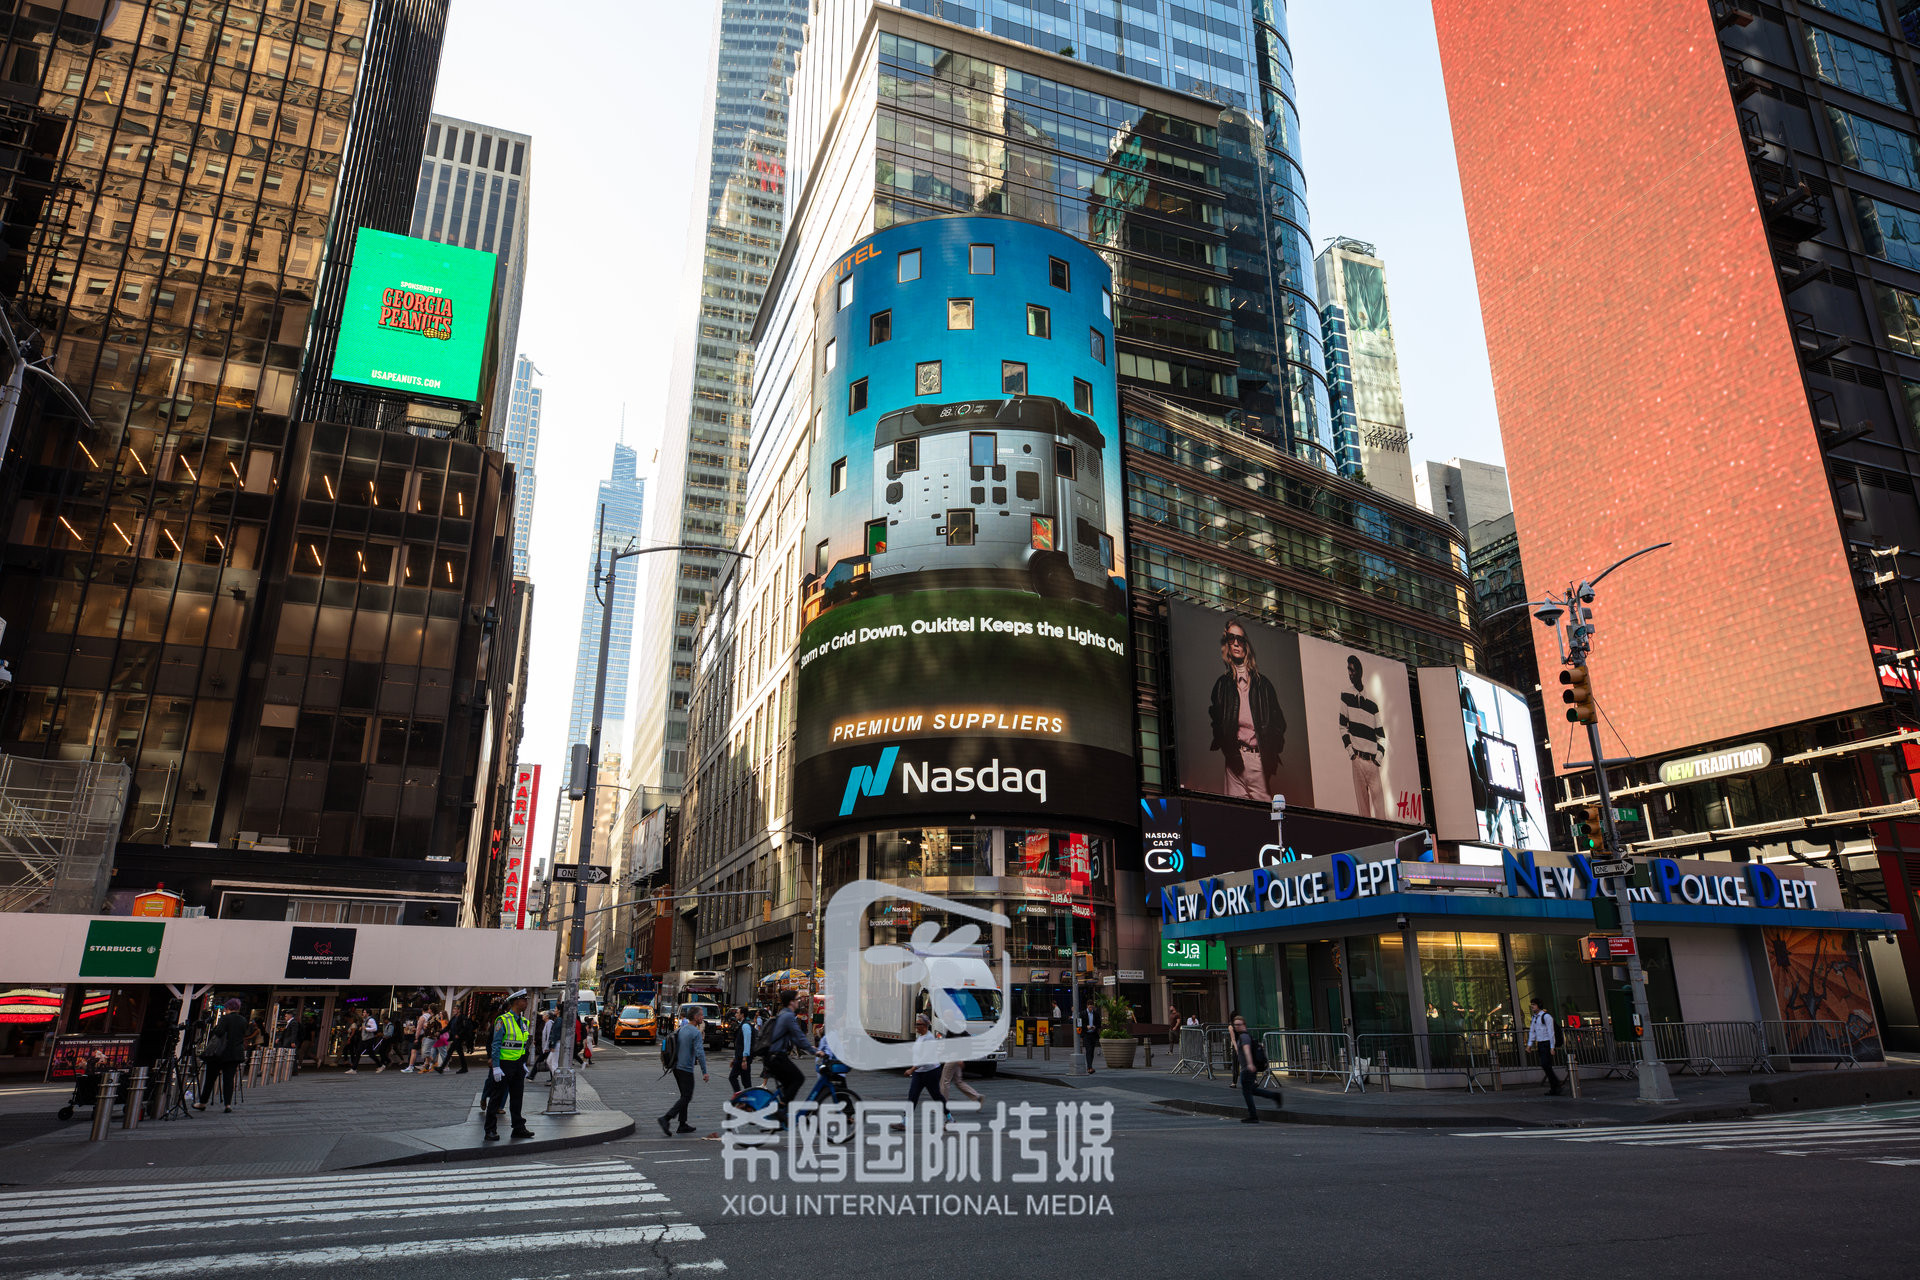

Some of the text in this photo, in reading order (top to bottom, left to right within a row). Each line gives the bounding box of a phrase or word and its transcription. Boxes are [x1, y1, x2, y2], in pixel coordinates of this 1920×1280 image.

[382, 287, 453, 318] GEORGIA
[401, 281, 434, 293] SPONSORED
[378, 306, 453, 334] PEANUTS
[371, 369, 441, 389] USAPEANUTS.COM
[819, 641, 830, 656] or
[831, 630, 856, 650] Grid
[859, 624, 907, 643] Down,
[911, 616, 975, 634] Oukitel
[980, 617, 1033, 636] Keeps
[1037, 621, 1064, 638] the
[1067, 625, 1106, 648] Lights
[1107, 637, 1124, 656] On!
[832, 713, 1064, 742] PREMIUM SUPPLIERS
[902, 758, 1047, 803] Nasdaq
[513, 772, 530, 825] PARK
[1397, 791, 1422, 822] H&M
[1145, 832, 1181, 840] NASDAQ:
[504, 858, 520, 912] PARK
[1161, 853, 1398, 925] NEW YORK POLICE DEPT
[1502, 848, 1576, 899] NEW
[1654, 858, 1749, 907] POLICE
[1750, 864, 1817, 910] DEPT
[89, 945, 142, 953] STARBUCKS
